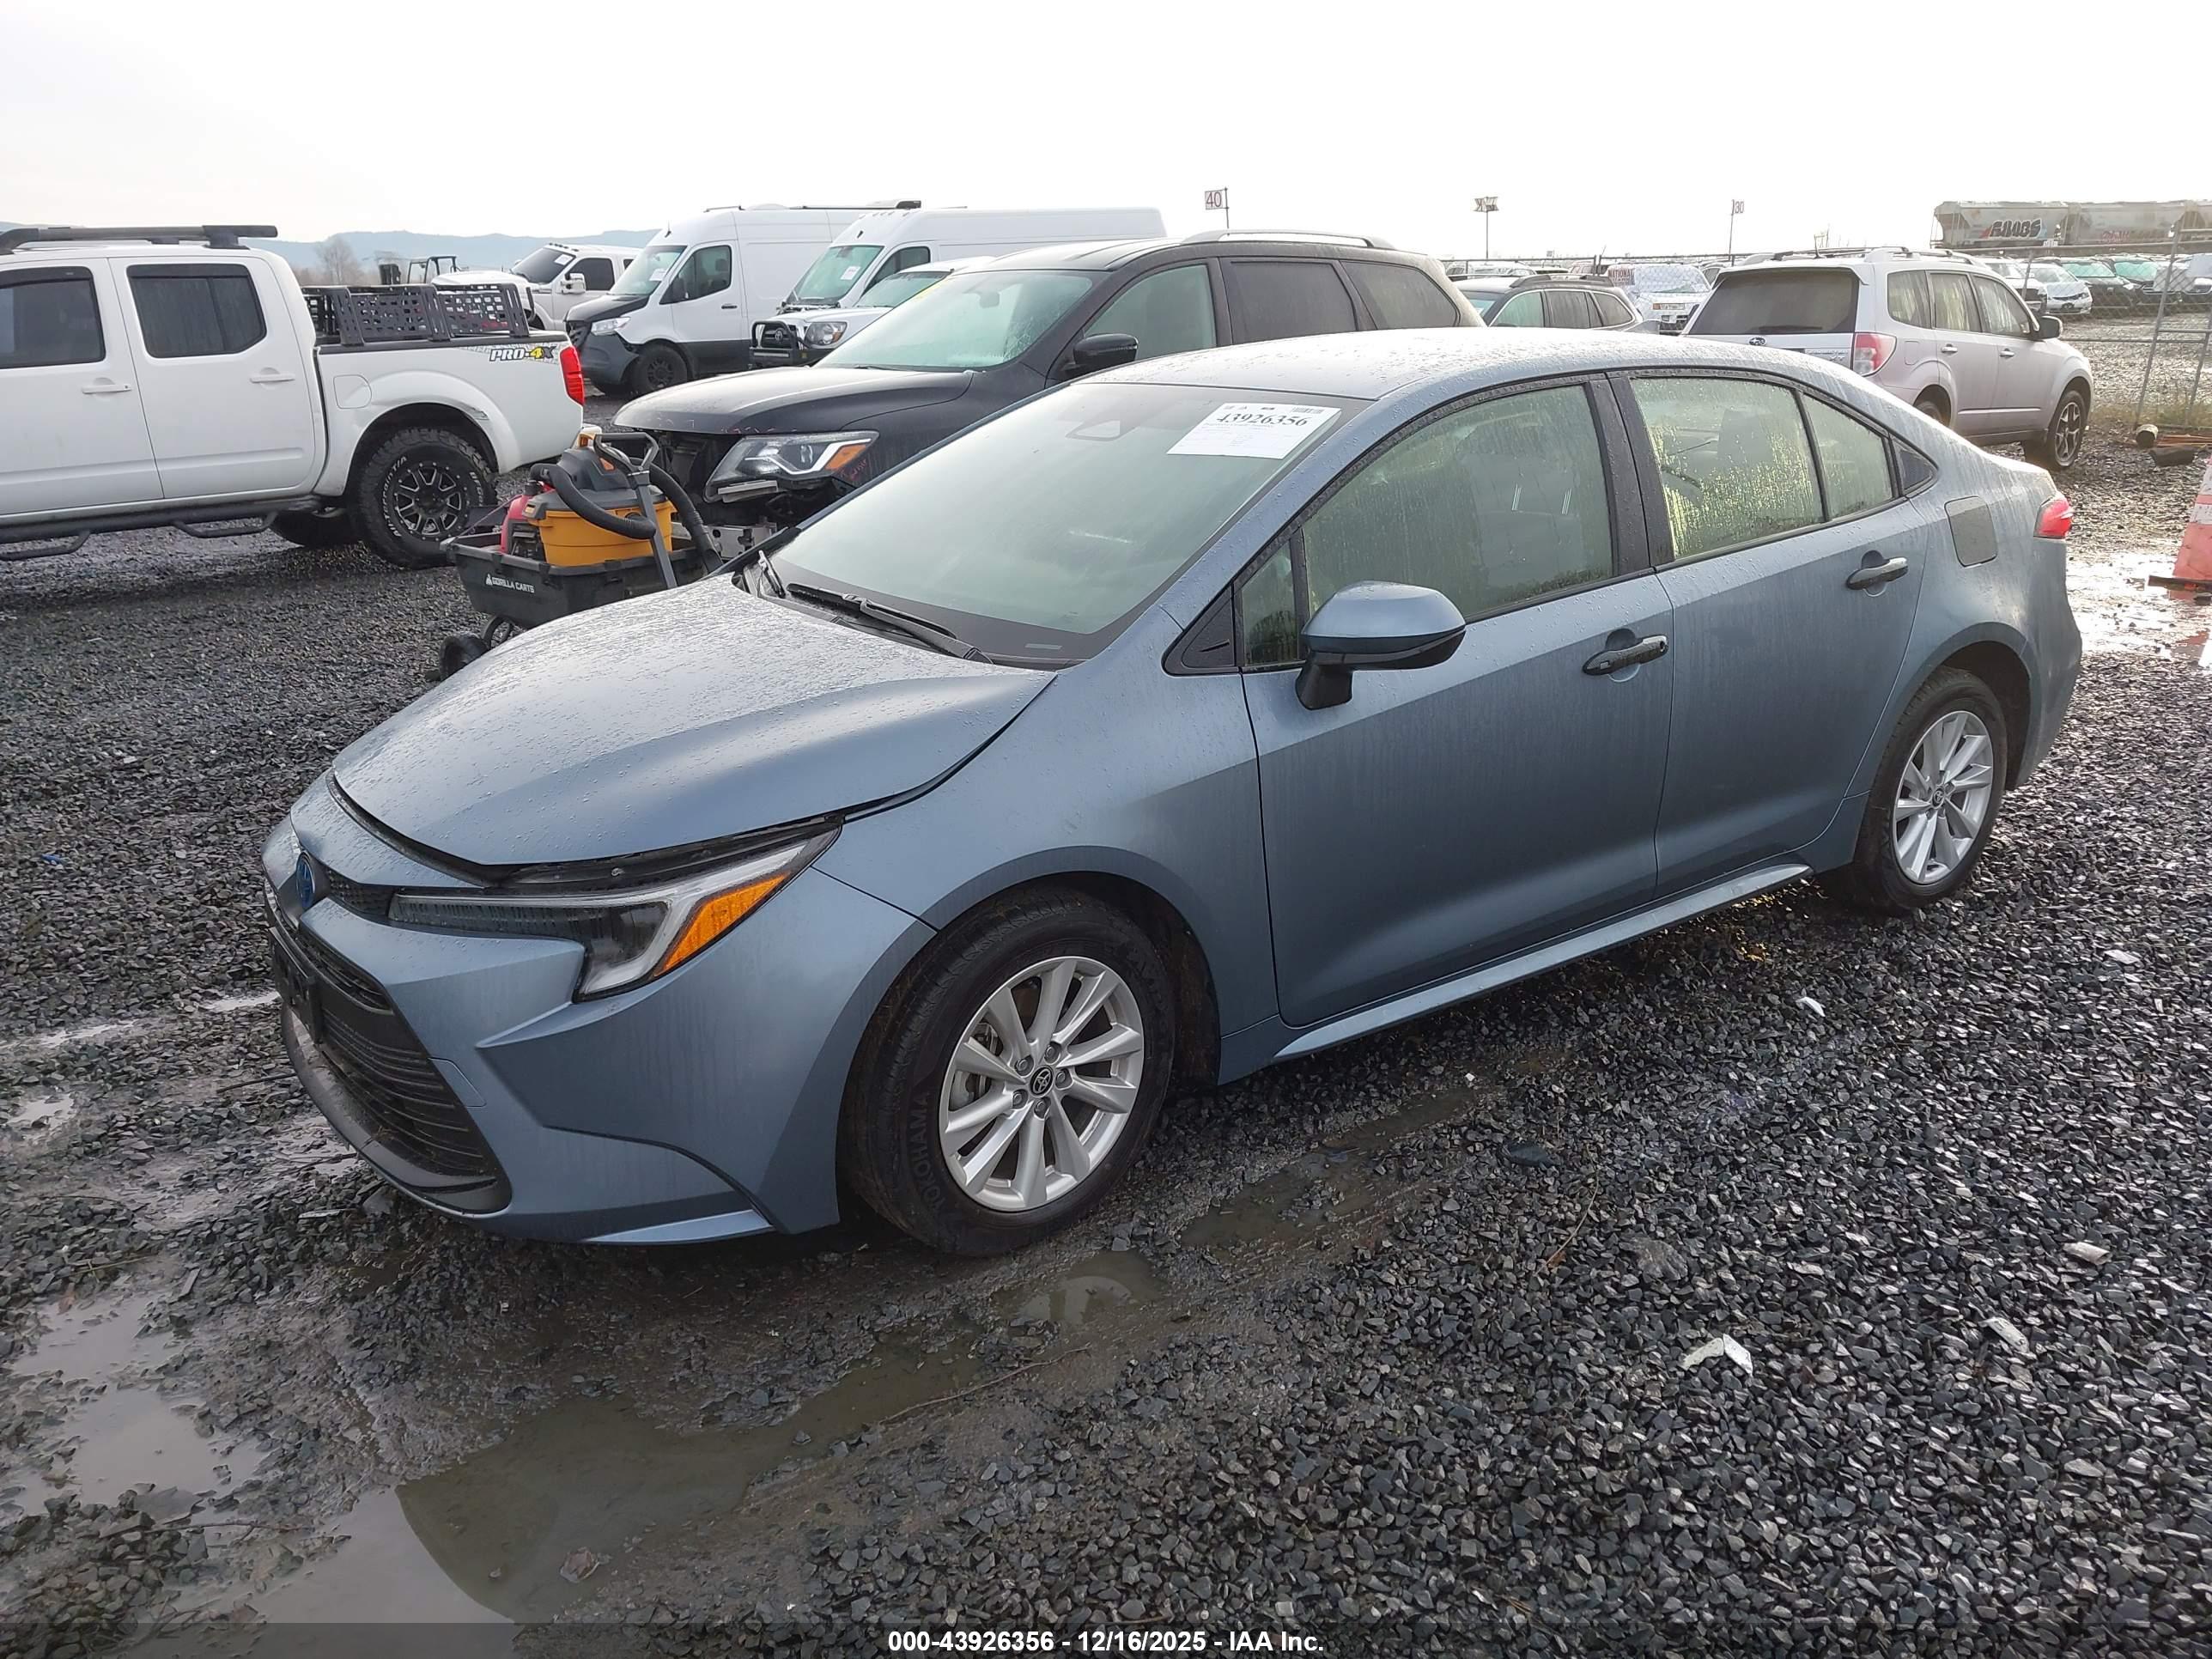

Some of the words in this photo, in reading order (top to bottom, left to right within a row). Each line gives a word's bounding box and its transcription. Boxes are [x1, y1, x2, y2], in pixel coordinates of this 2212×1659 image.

[1206, 191, 1221, 207] 40
[489, 346, 556, 362] PRO-4X
[1216, 412, 1311, 427] 43926356
[492, 576, 515, 590] GORILLA
[515, 581, 535, 593] CARTS
